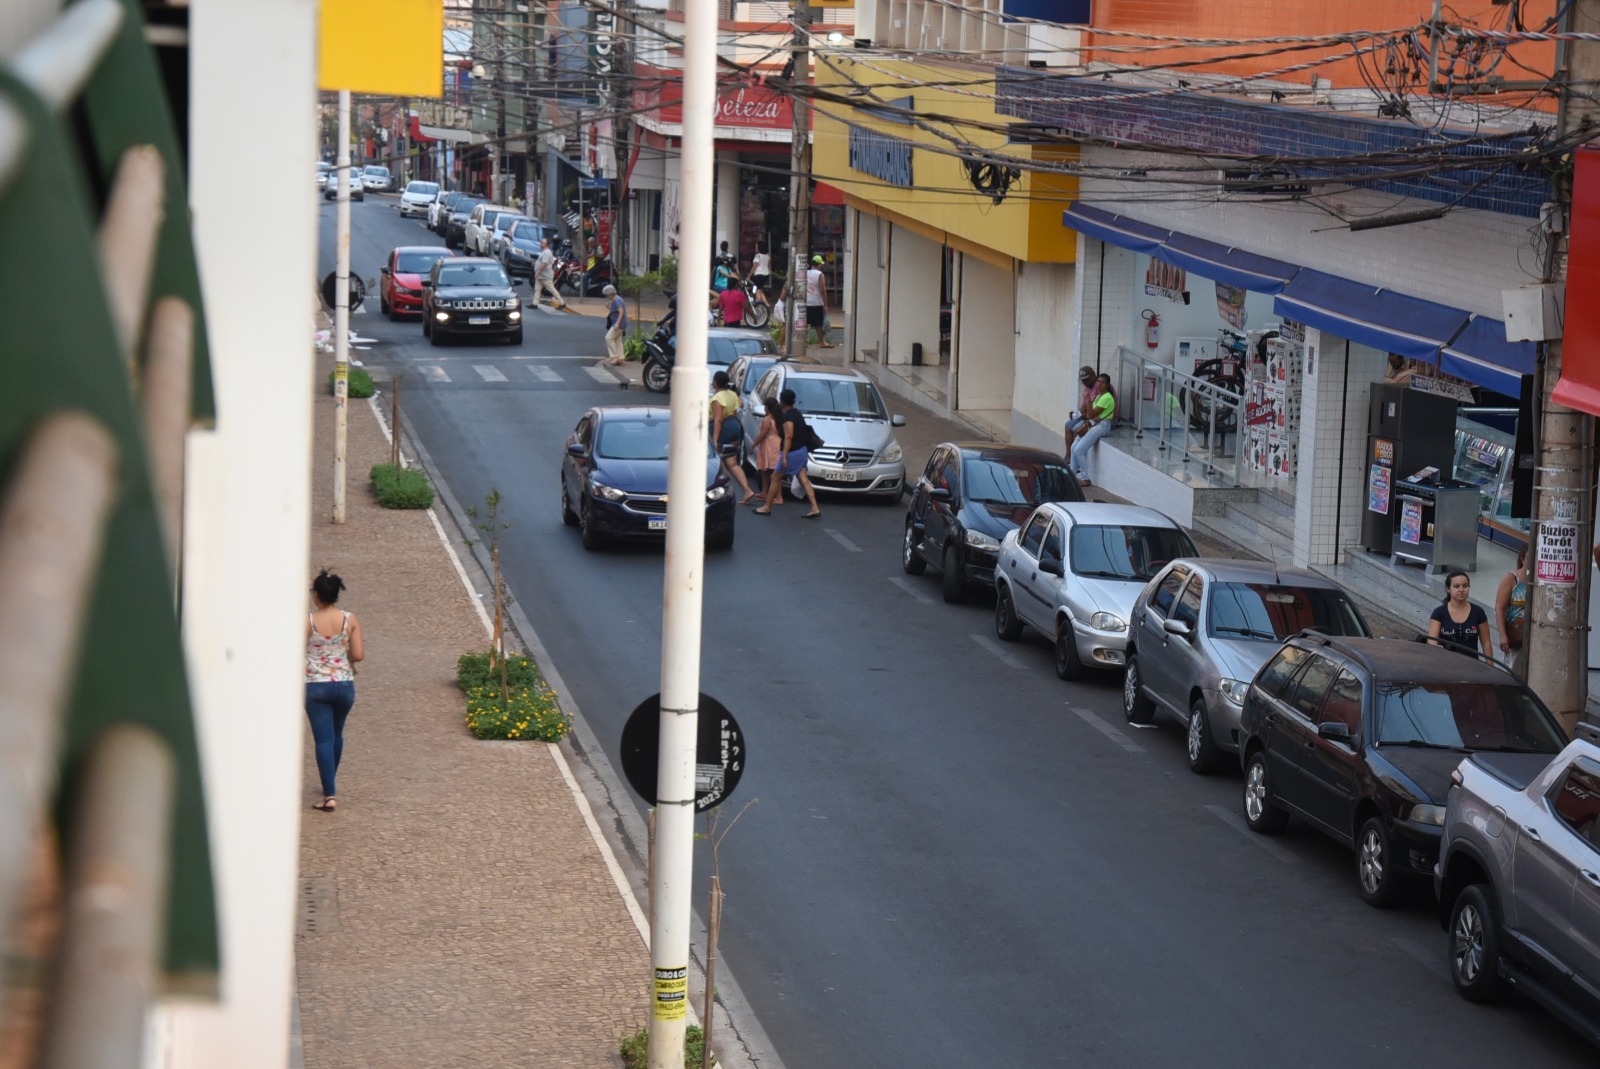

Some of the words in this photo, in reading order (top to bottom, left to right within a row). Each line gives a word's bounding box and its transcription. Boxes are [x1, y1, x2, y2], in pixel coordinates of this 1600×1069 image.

[1540, 524, 1575, 536] Búzios
[1542, 536, 1572, 546] Tarôt
[697, 791, 721, 808] 2023
